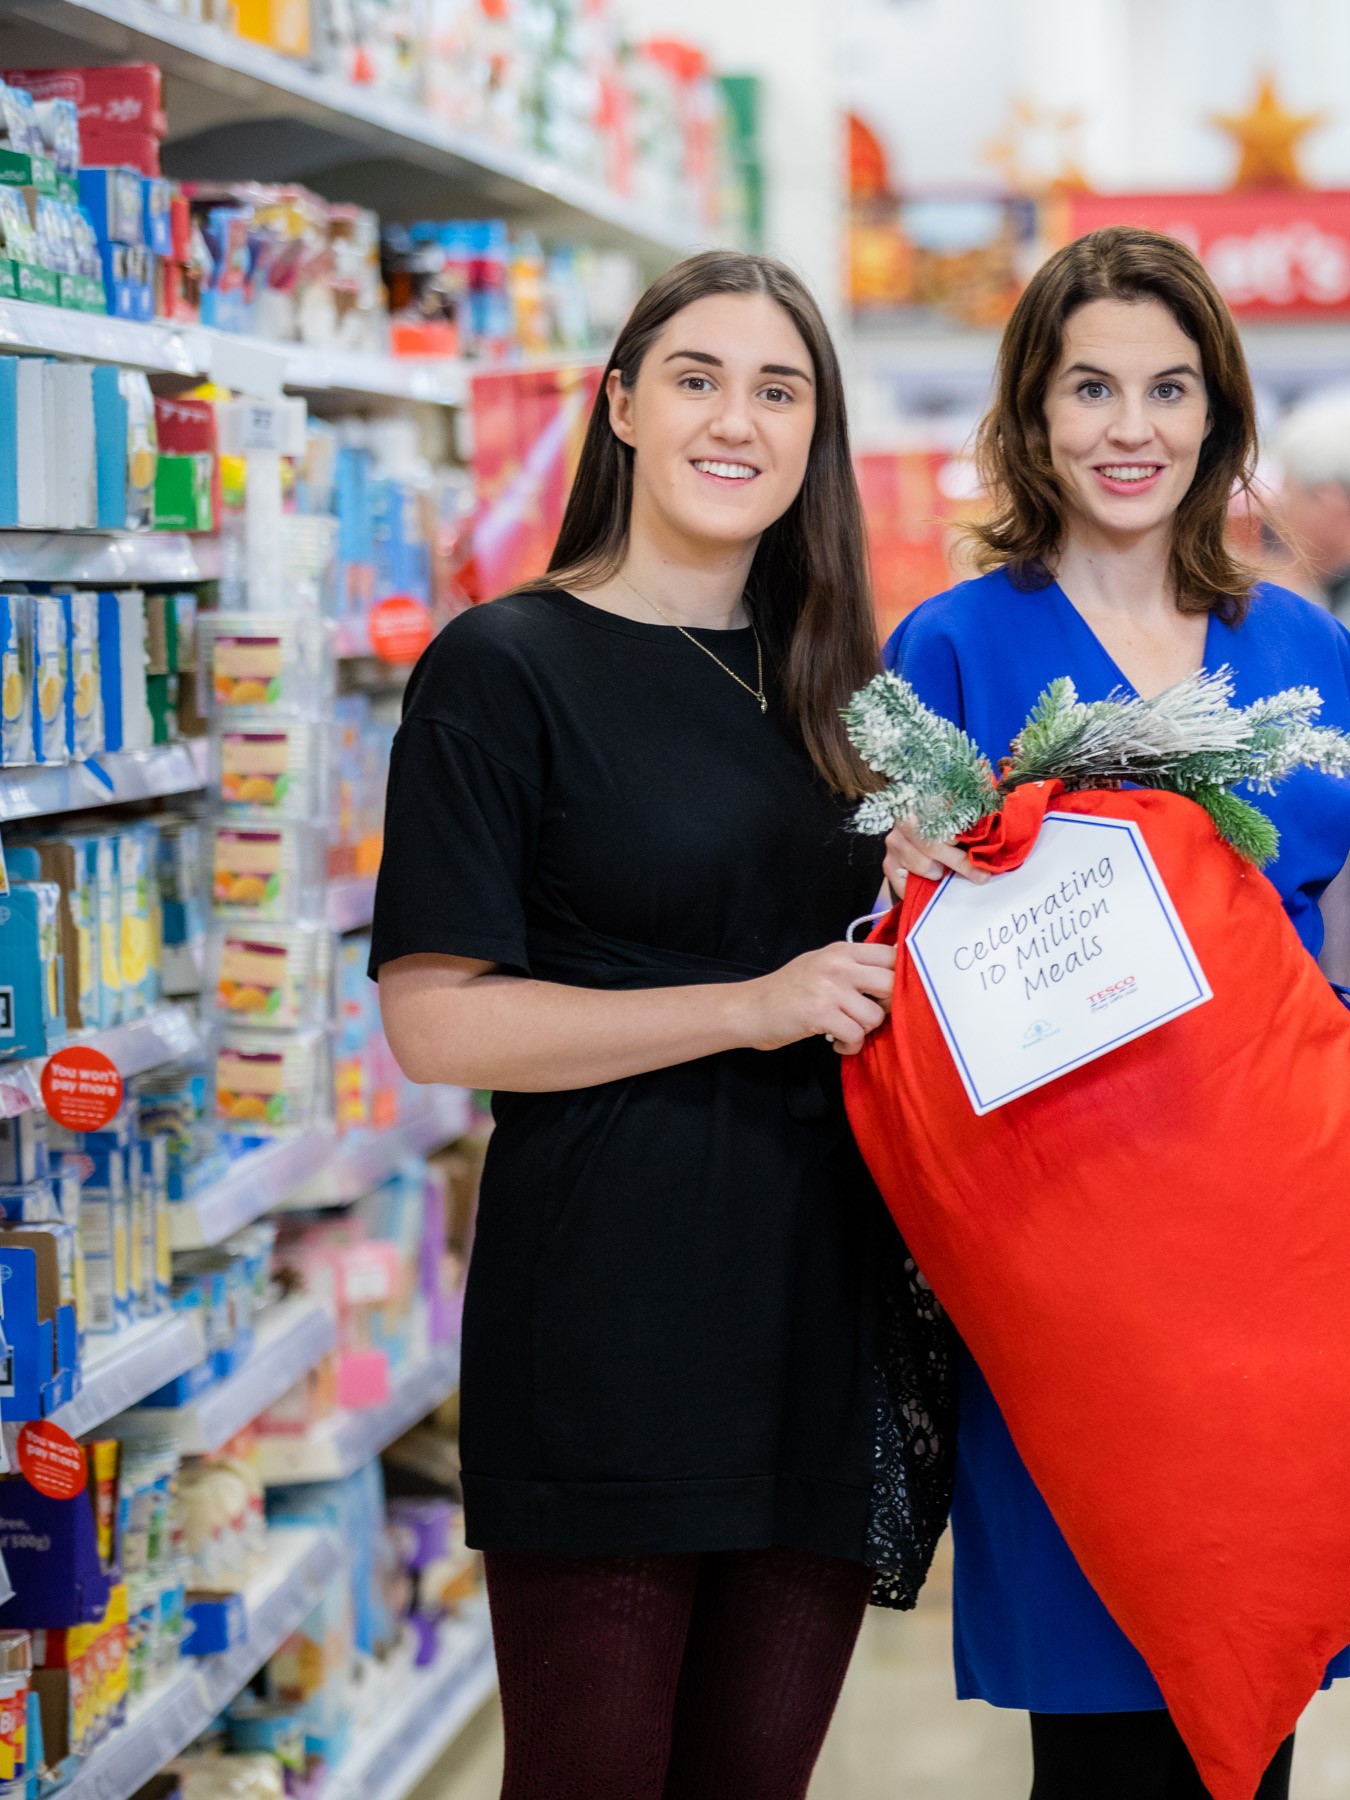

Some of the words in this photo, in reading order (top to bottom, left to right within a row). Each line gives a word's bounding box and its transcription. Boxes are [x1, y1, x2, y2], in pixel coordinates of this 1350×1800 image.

[954, 857, 1114, 970] Celebrating
[980, 964, 1006, 990] 10
[1017, 898, 1110, 969] Million
[1025, 935, 1103, 1000] Meals
[1086, 976, 1135, 1003] TESCO
[51, 1063, 77, 1079] You
[79, 1069, 118, 1083] won't
[51, 1078, 77, 1094] pay
[79, 1082, 117, 1096] more
[25, 1429, 47, 1447] You
[47, 1440, 80, 1459] won't
[26, 1443, 48, 1460] pay
[49, 1451, 81, 1470] more
